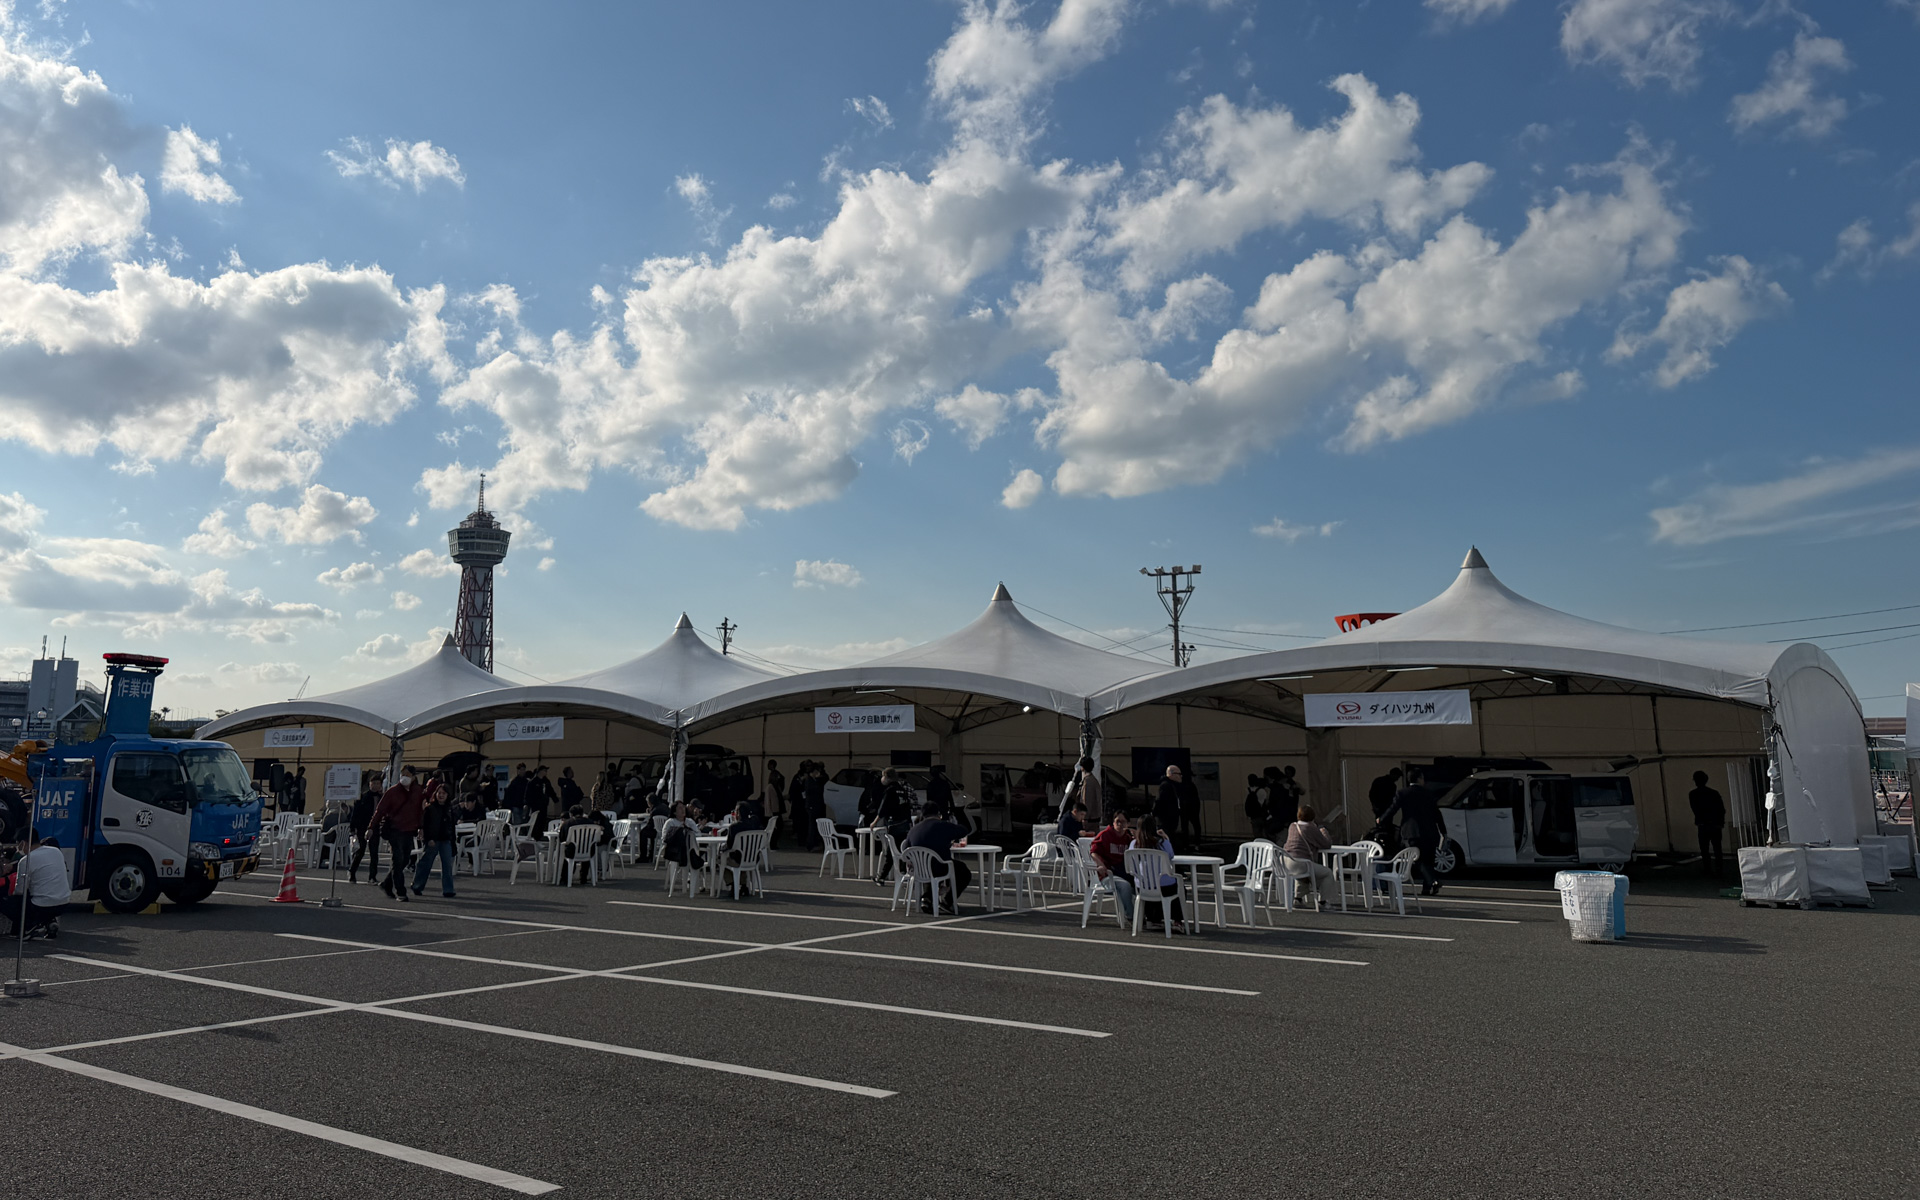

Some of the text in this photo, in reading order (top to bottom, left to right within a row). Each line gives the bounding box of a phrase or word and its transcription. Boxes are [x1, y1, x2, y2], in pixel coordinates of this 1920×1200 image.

[117, 676, 153, 699] 作業中
[1369, 702, 1435, 714] ダイハツ九州
[848, 714, 901, 724] トヨタ自動車九州
[40, 790, 75, 807] JAF
[231, 812, 250, 830] JAF
[160, 866, 181, 876] 104
